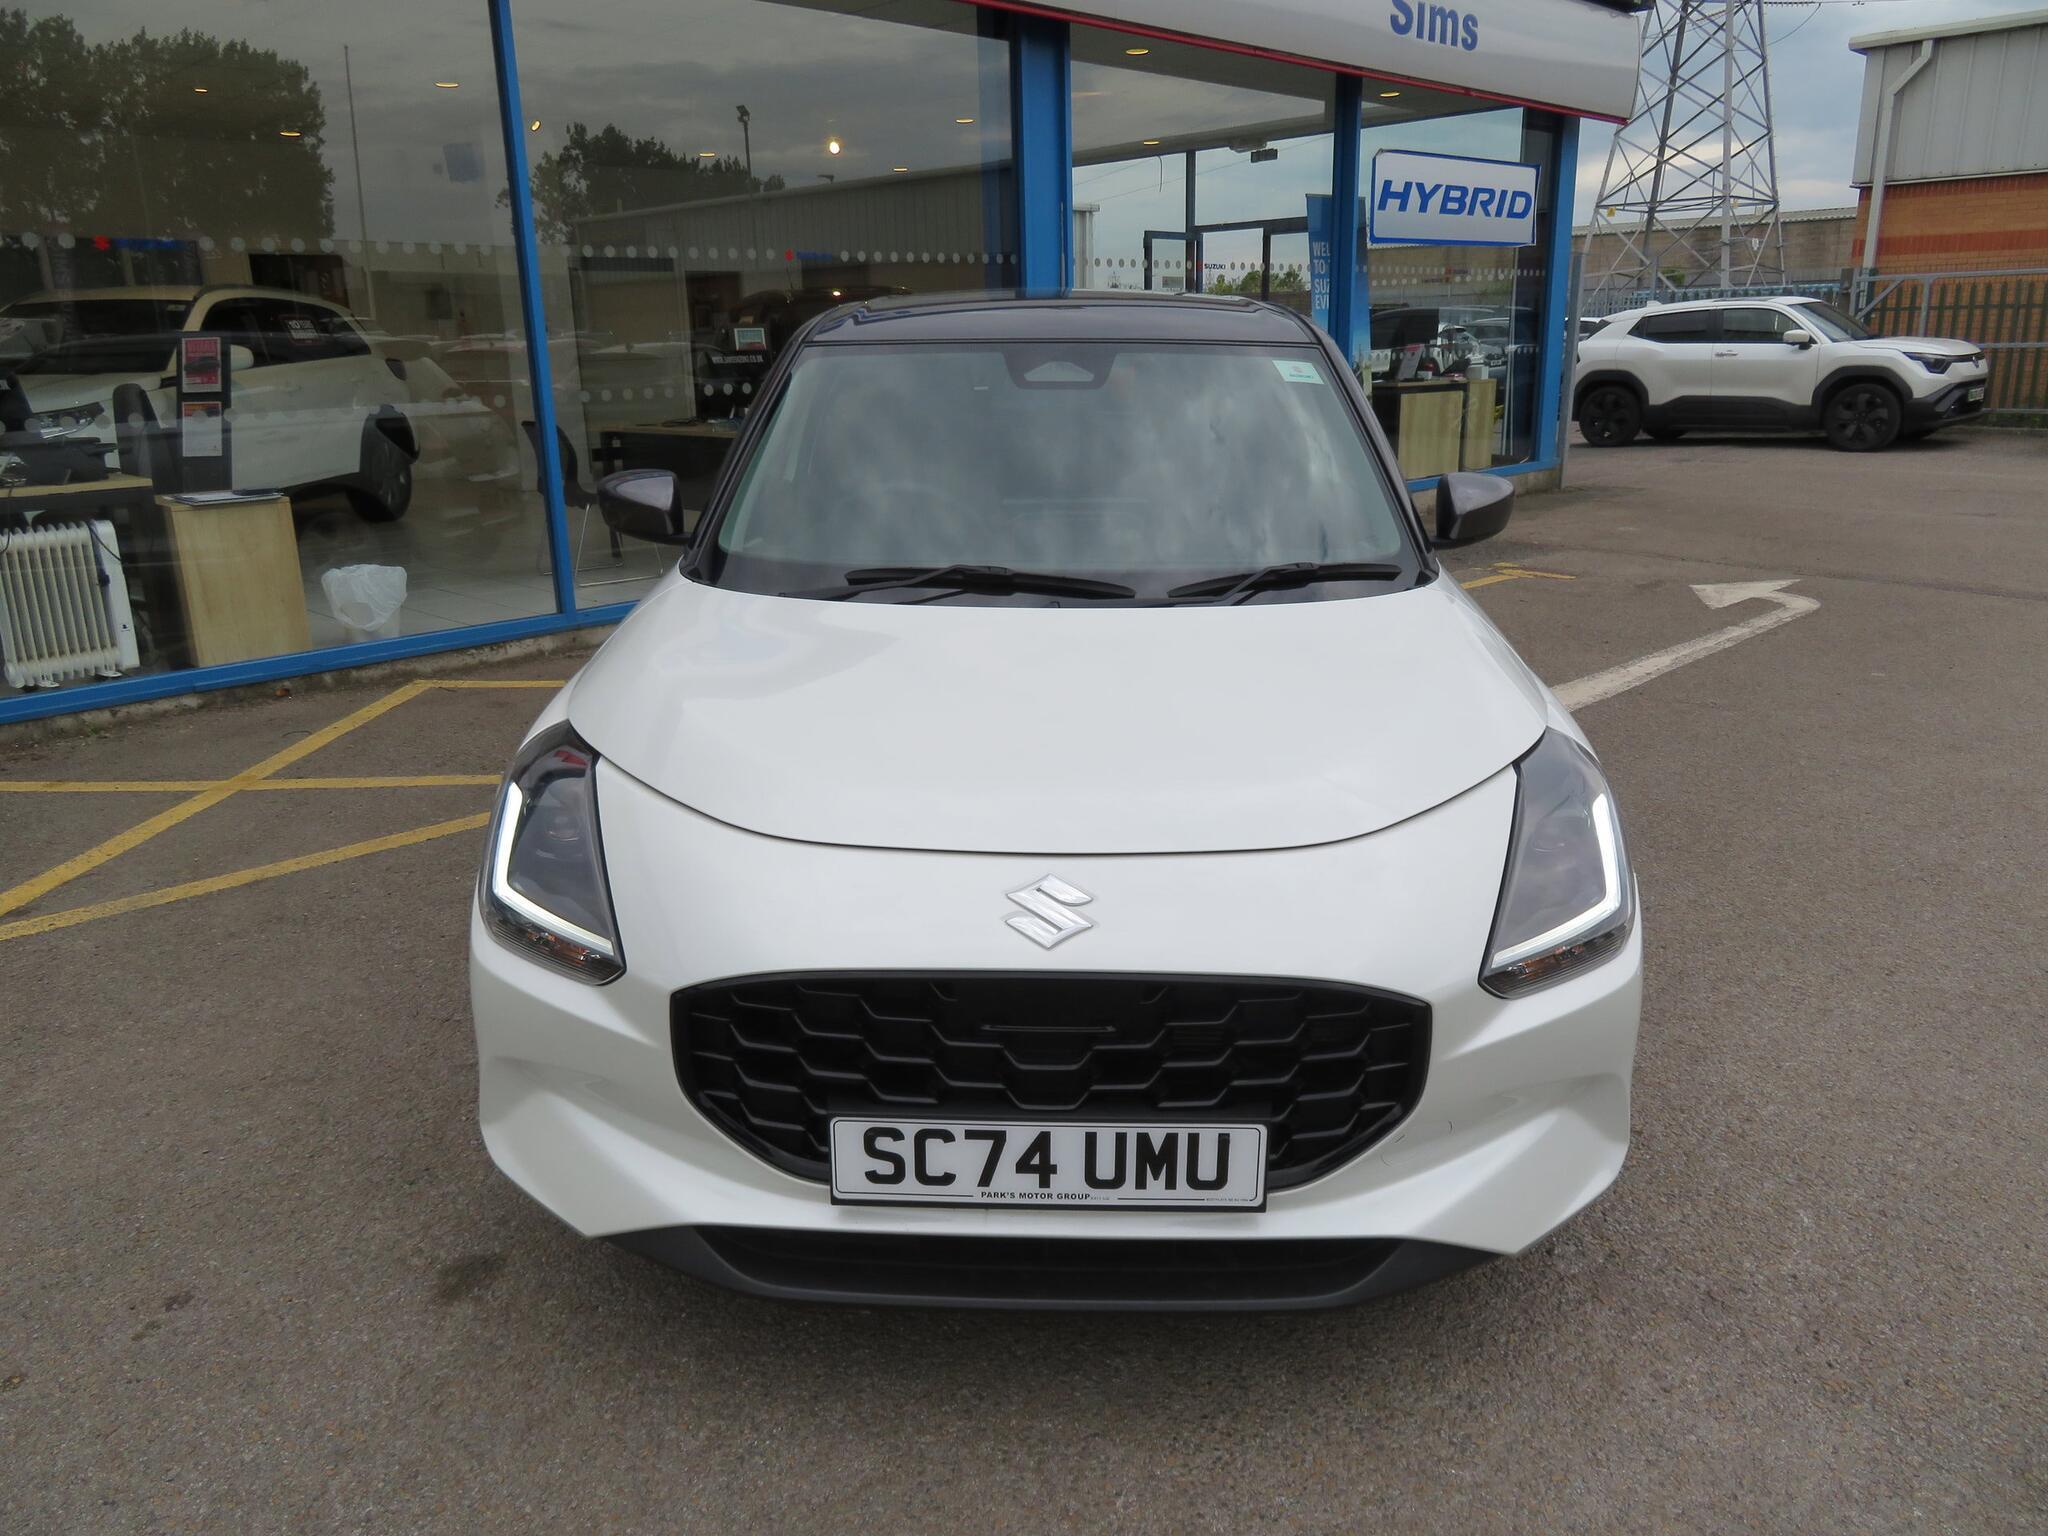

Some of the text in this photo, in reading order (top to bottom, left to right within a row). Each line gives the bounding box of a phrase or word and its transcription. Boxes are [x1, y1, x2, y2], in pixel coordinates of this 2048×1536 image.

[1390, 0, 1478, 51] Sims
[1377, 179, 1533, 220] HYBRID
[1312, 241, 1329, 257] WEL
[1313, 259, 1325, 274] TO
[863, 1126, 1231, 1191] SC74 UMU
[981, 1191, 1015, 1199] PARK'S
[1019, 1192, 1053, 1200] MOTOR
[1056, 1193, 1090, 1201] GROUP
